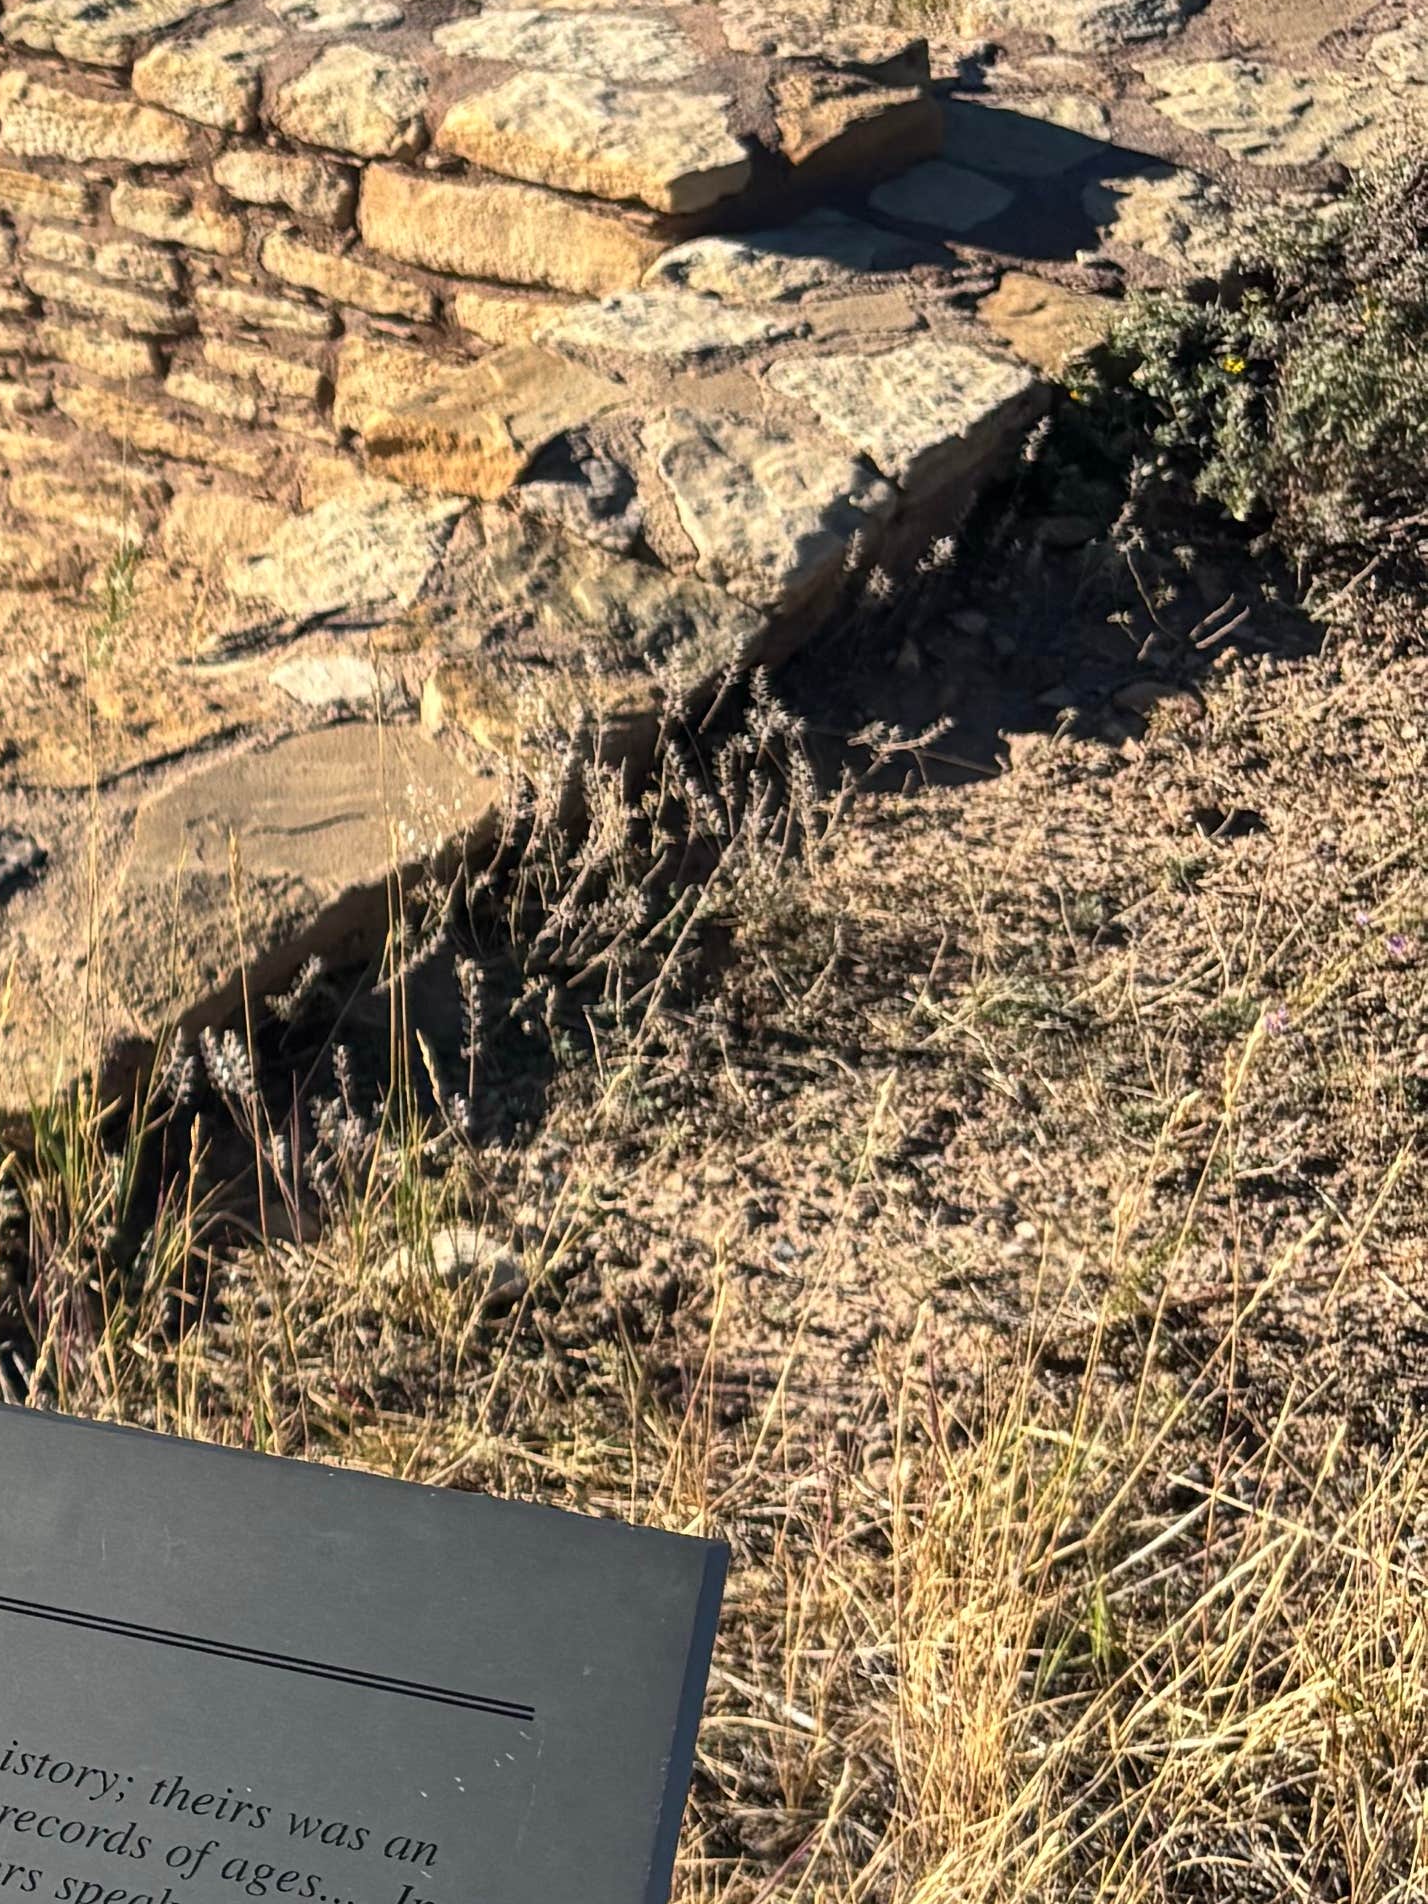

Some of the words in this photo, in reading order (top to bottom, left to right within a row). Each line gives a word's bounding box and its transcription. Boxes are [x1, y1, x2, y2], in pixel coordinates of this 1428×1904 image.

[147, 1773, 273, 1830] theirs
[287, 1810, 372, 1852] was
[381, 1834, 439, 1868] an
[163, 1838, 221, 1881] of
